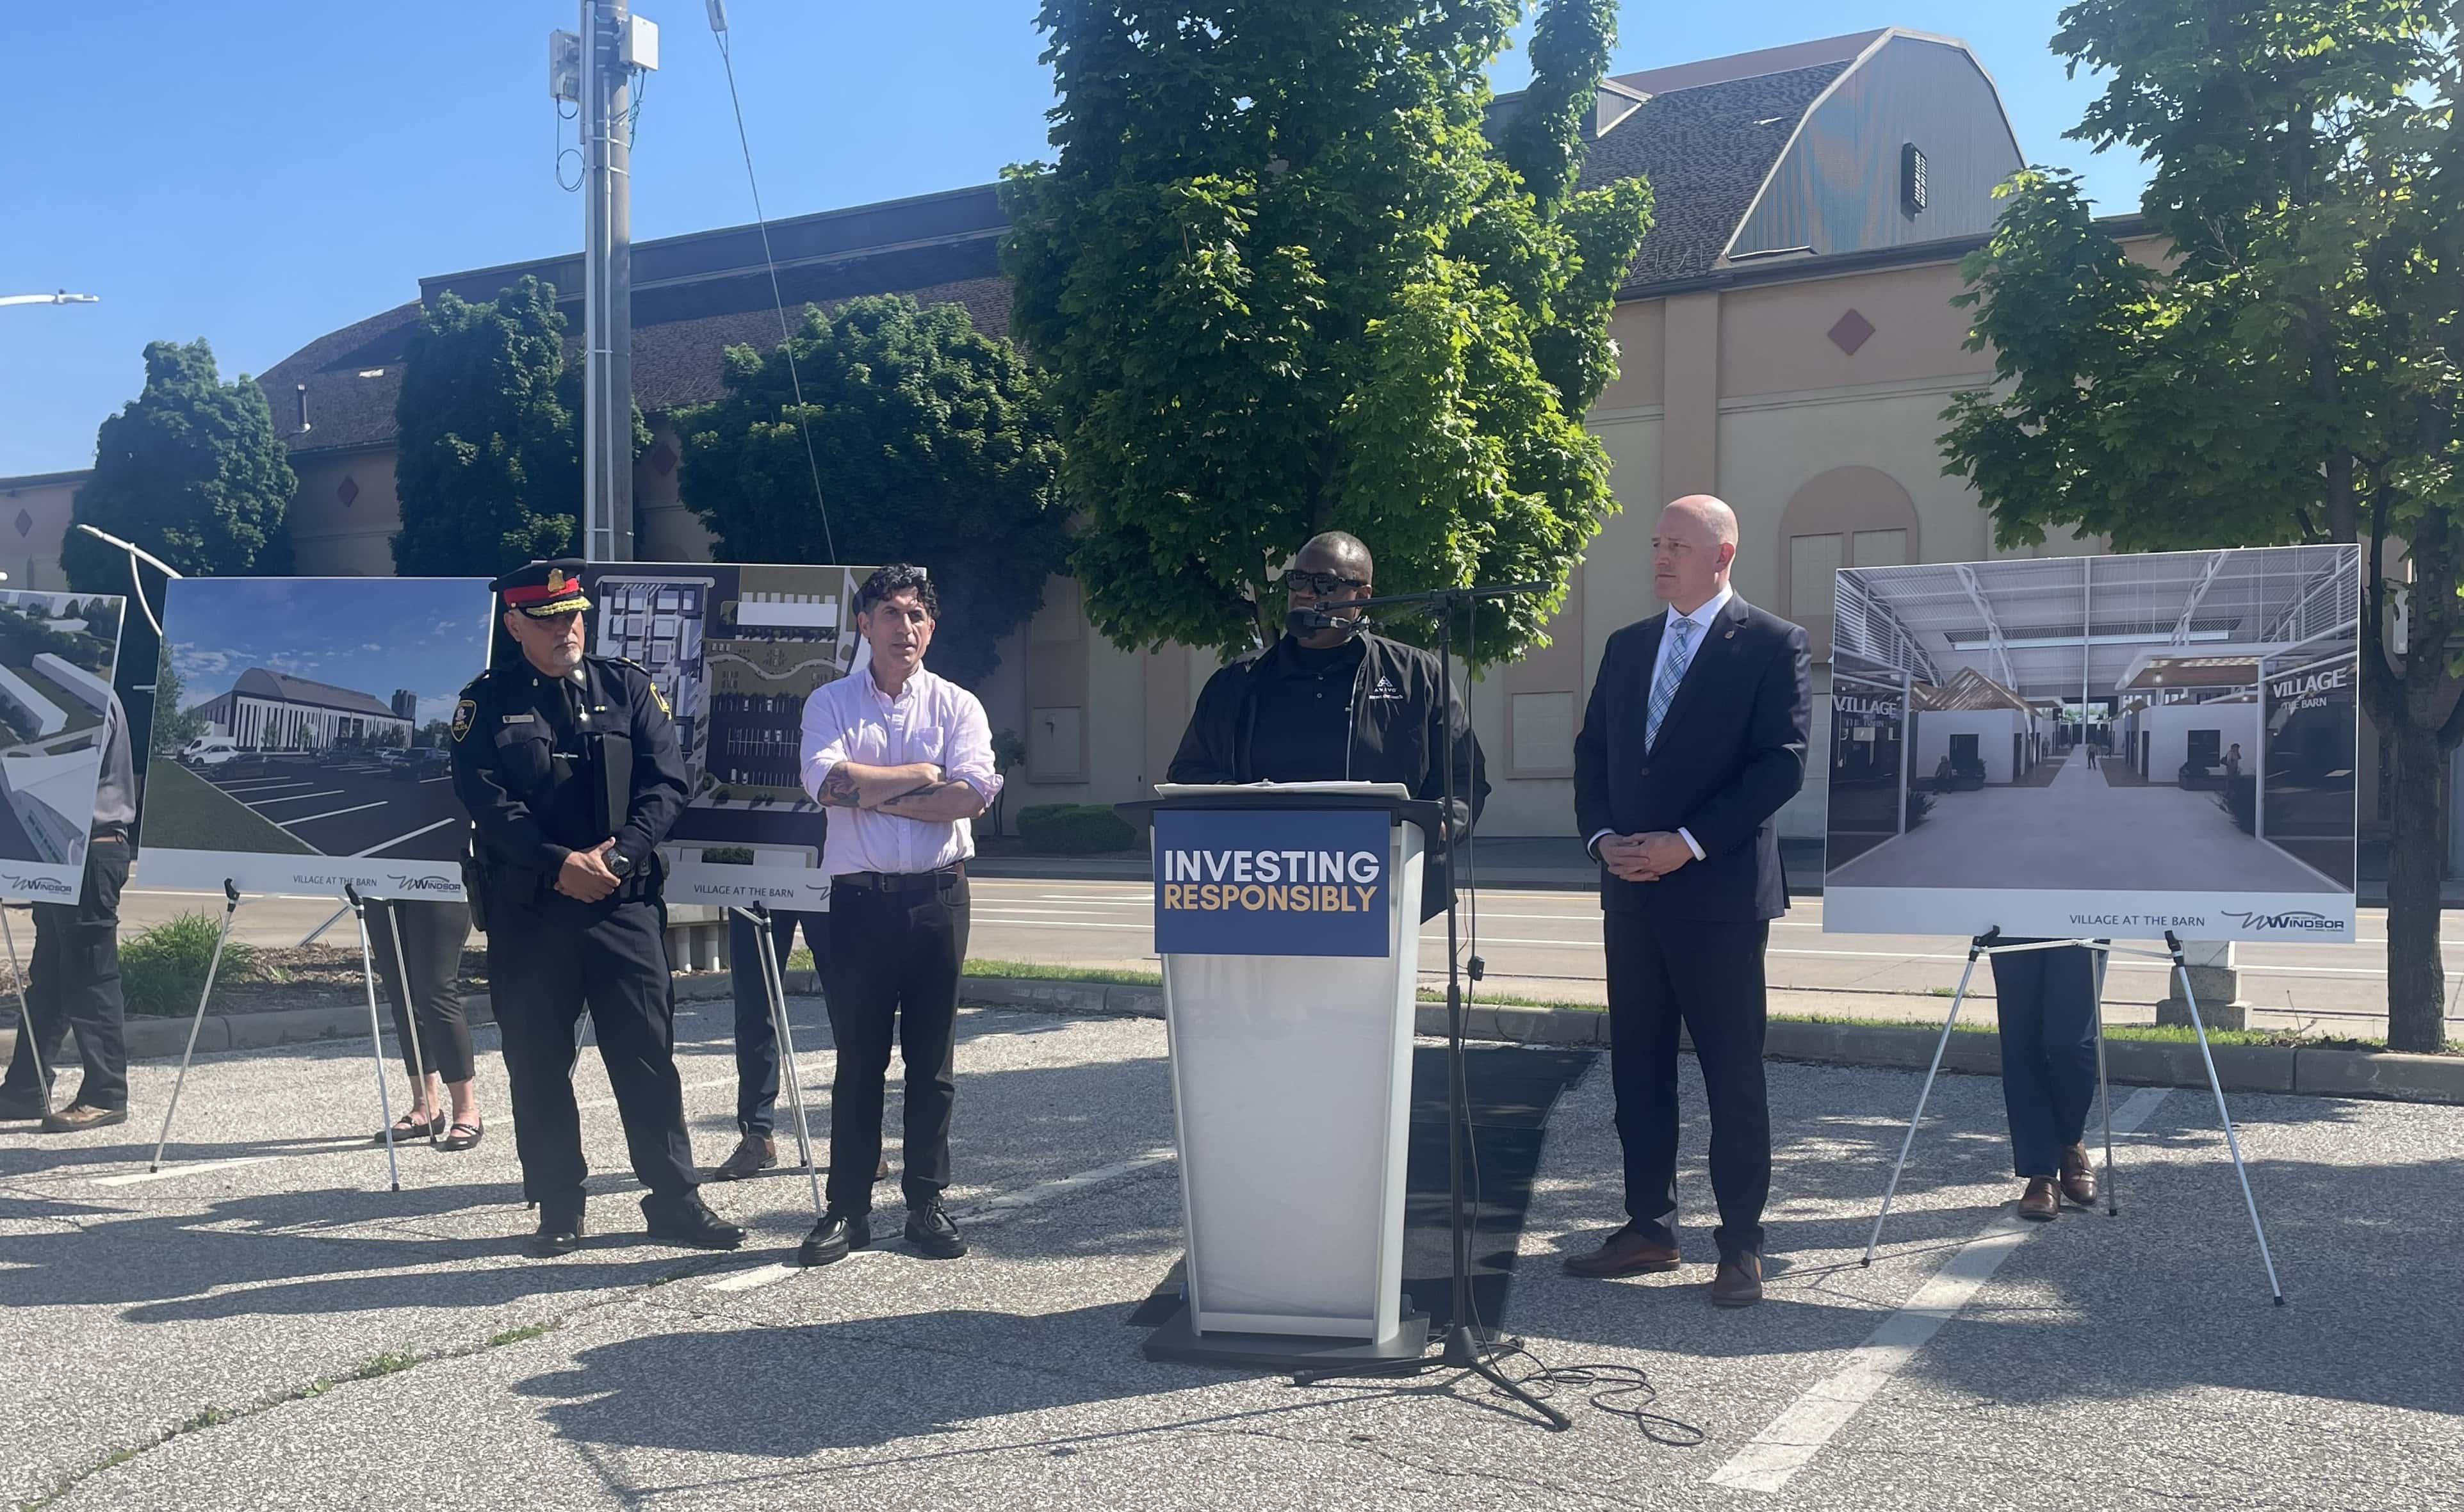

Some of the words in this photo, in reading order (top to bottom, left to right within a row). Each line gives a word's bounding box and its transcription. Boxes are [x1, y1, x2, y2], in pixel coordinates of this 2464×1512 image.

[2273, 667, 2347, 698] VILLAGE
[1833, 695, 1897, 715] VILLAGE
[2301, 697, 2326, 709] BARN
[1164, 850, 1380, 883] INVESTING
[28, 879, 72, 892] WINDSOR
[293, 875, 323, 884] VILLAGE
[356, 878, 377, 887] BARN
[414, 879, 461, 890] WINDSOR
[694, 884, 730, 895] VILLAGE
[733, 886, 746, 895] AT
[749, 887, 767, 897] THE
[769, 888, 794, 897] BARN
[1164, 884, 1378, 912] RESPONSIBLY
[2069, 915, 2119, 925] VILLAGE
[2123, 915, 2140, 925] AT
[2143, 916, 2167, 926] THE
[2172, 916, 2205, 927] BARN
[2267, 916, 2344, 929] WINDSOR
